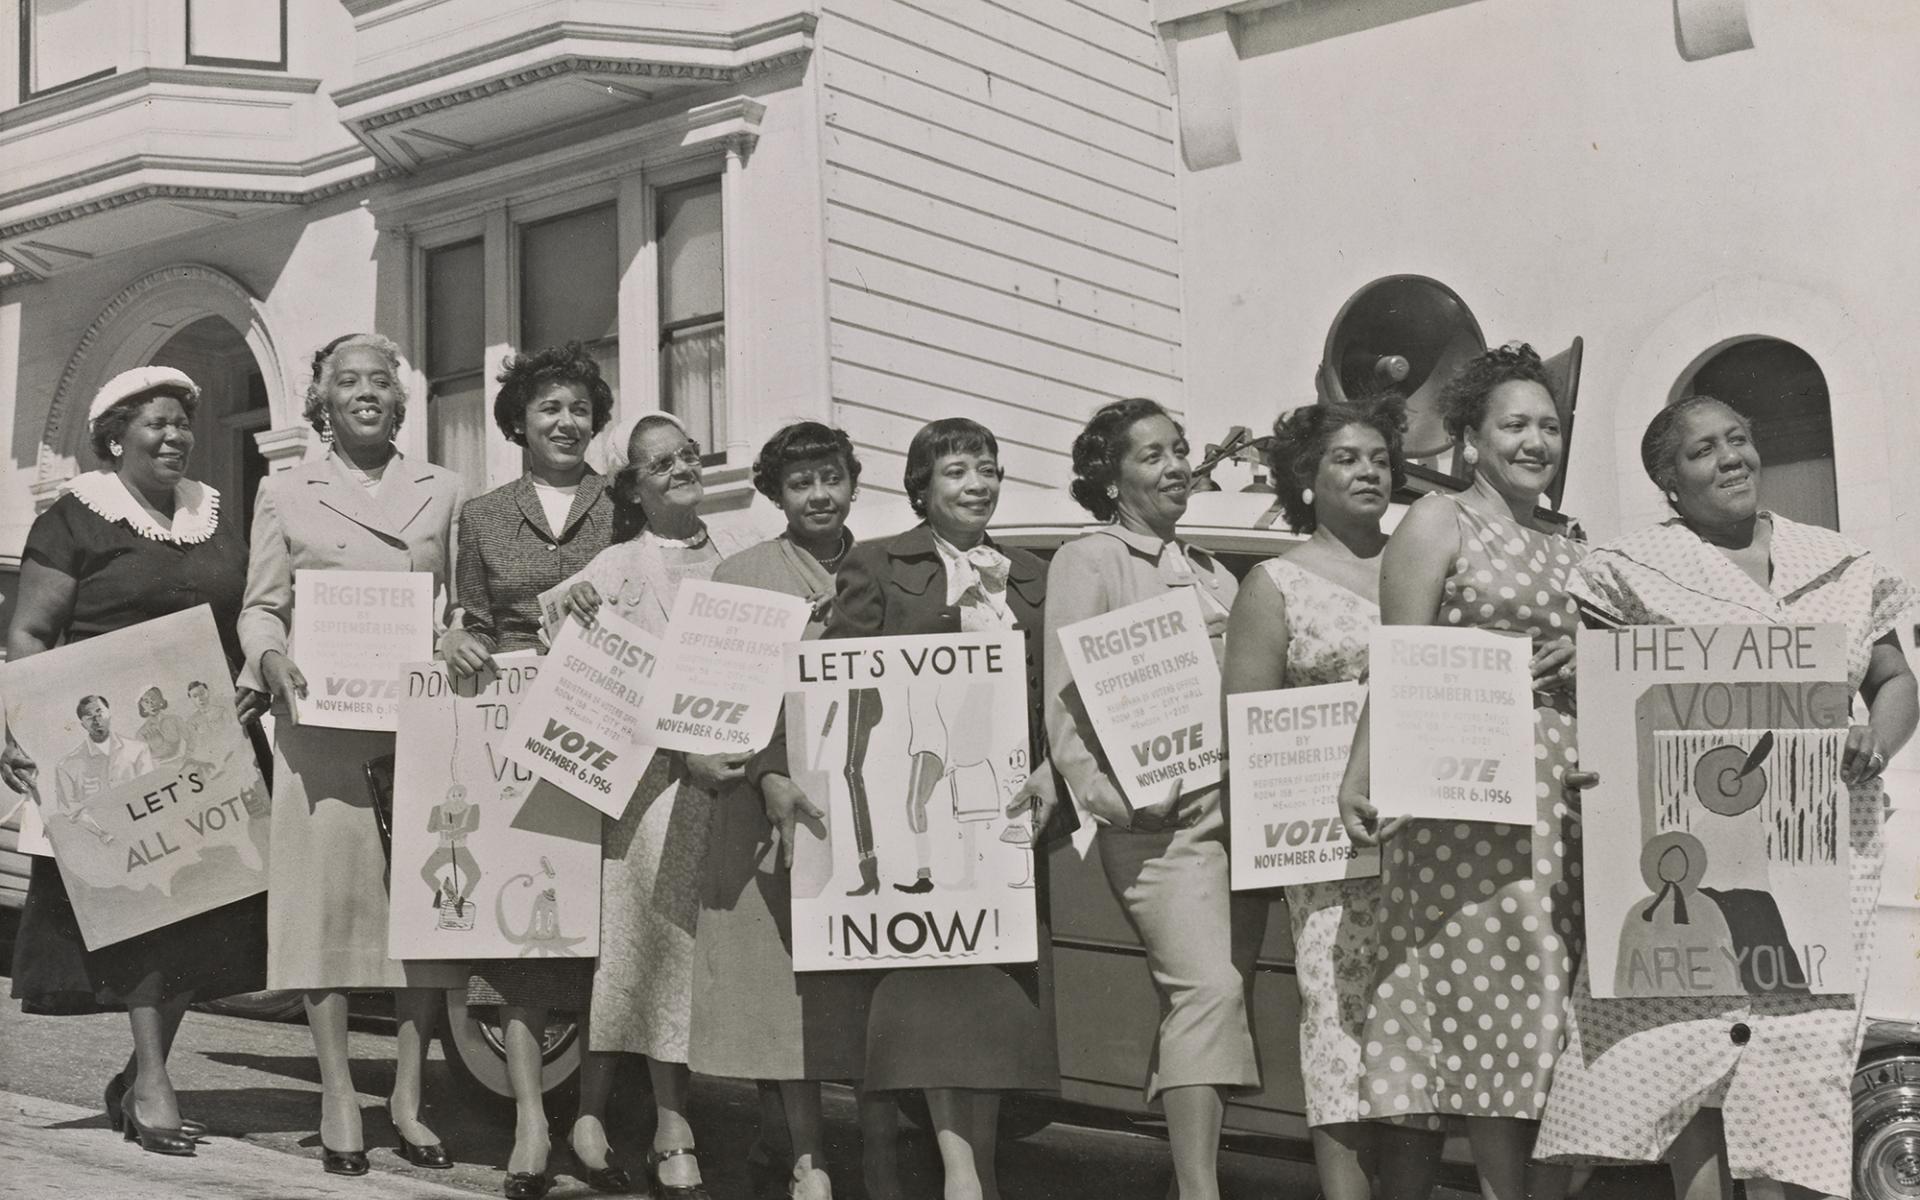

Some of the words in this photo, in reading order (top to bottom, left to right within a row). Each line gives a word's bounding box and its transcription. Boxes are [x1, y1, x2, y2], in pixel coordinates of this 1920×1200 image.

[313, 582, 416, 608] REGISTER
[688, 592, 792, 629] REGISTER
[312, 620, 381, 635] SEPTEMBER
[680, 631, 745, 652] SEPTEMBER
[1078, 610, 1188, 664] REGISTER
[577, 620, 657, 679] REGIST
[799, 649, 885, 682] LET'S
[900, 644, 1003, 676] VOTE
[1131, 652, 1146, 666] BY
[1391, 639, 1513, 673] REGISTER
[1608, 627, 1719, 671] THEY
[1732, 626, 1816, 670] ARE
[325, 677, 400, 699] VOTE
[563, 654, 627, 699] SEPTEMBER
[609, 665, 627, 679] BY
[1095, 663, 1162, 697] SEPTEMBER
[1443, 673, 1459, 684] BY
[316, 699, 373, 713] NOVEMBER
[672, 693, 750, 725] VOTE
[1391, 684, 1471, 702] SEPTEMBER
[1665, 681, 1836, 730] VOTING
[476, 703, 509, 732] TO
[656, 717, 713, 739] NOVEMBER
[1246, 700, 1359, 735] REGISTER
[524, 736, 579, 776] NOVEMBER
[543, 717, 619, 771] VOTE
[1130, 721, 1204, 768] VOTE
[1295, 735, 1312, 746] BY
[1136, 760, 1188, 788] NOVEMBER
[1249, 747, 1321, 770] SEPTEMBER
[1431, 756, 1501, 783] OTE
[125, 772, 204, 822] LET'S
[127, 831, 181, 873] ALL
[184, 785, 266, 836] VOTE
[1263, 817, 1346, 849] VOTE
[1254, 849, 1317, 870] NOVEMBER
[1627, 945, 1712, 990] ARE
